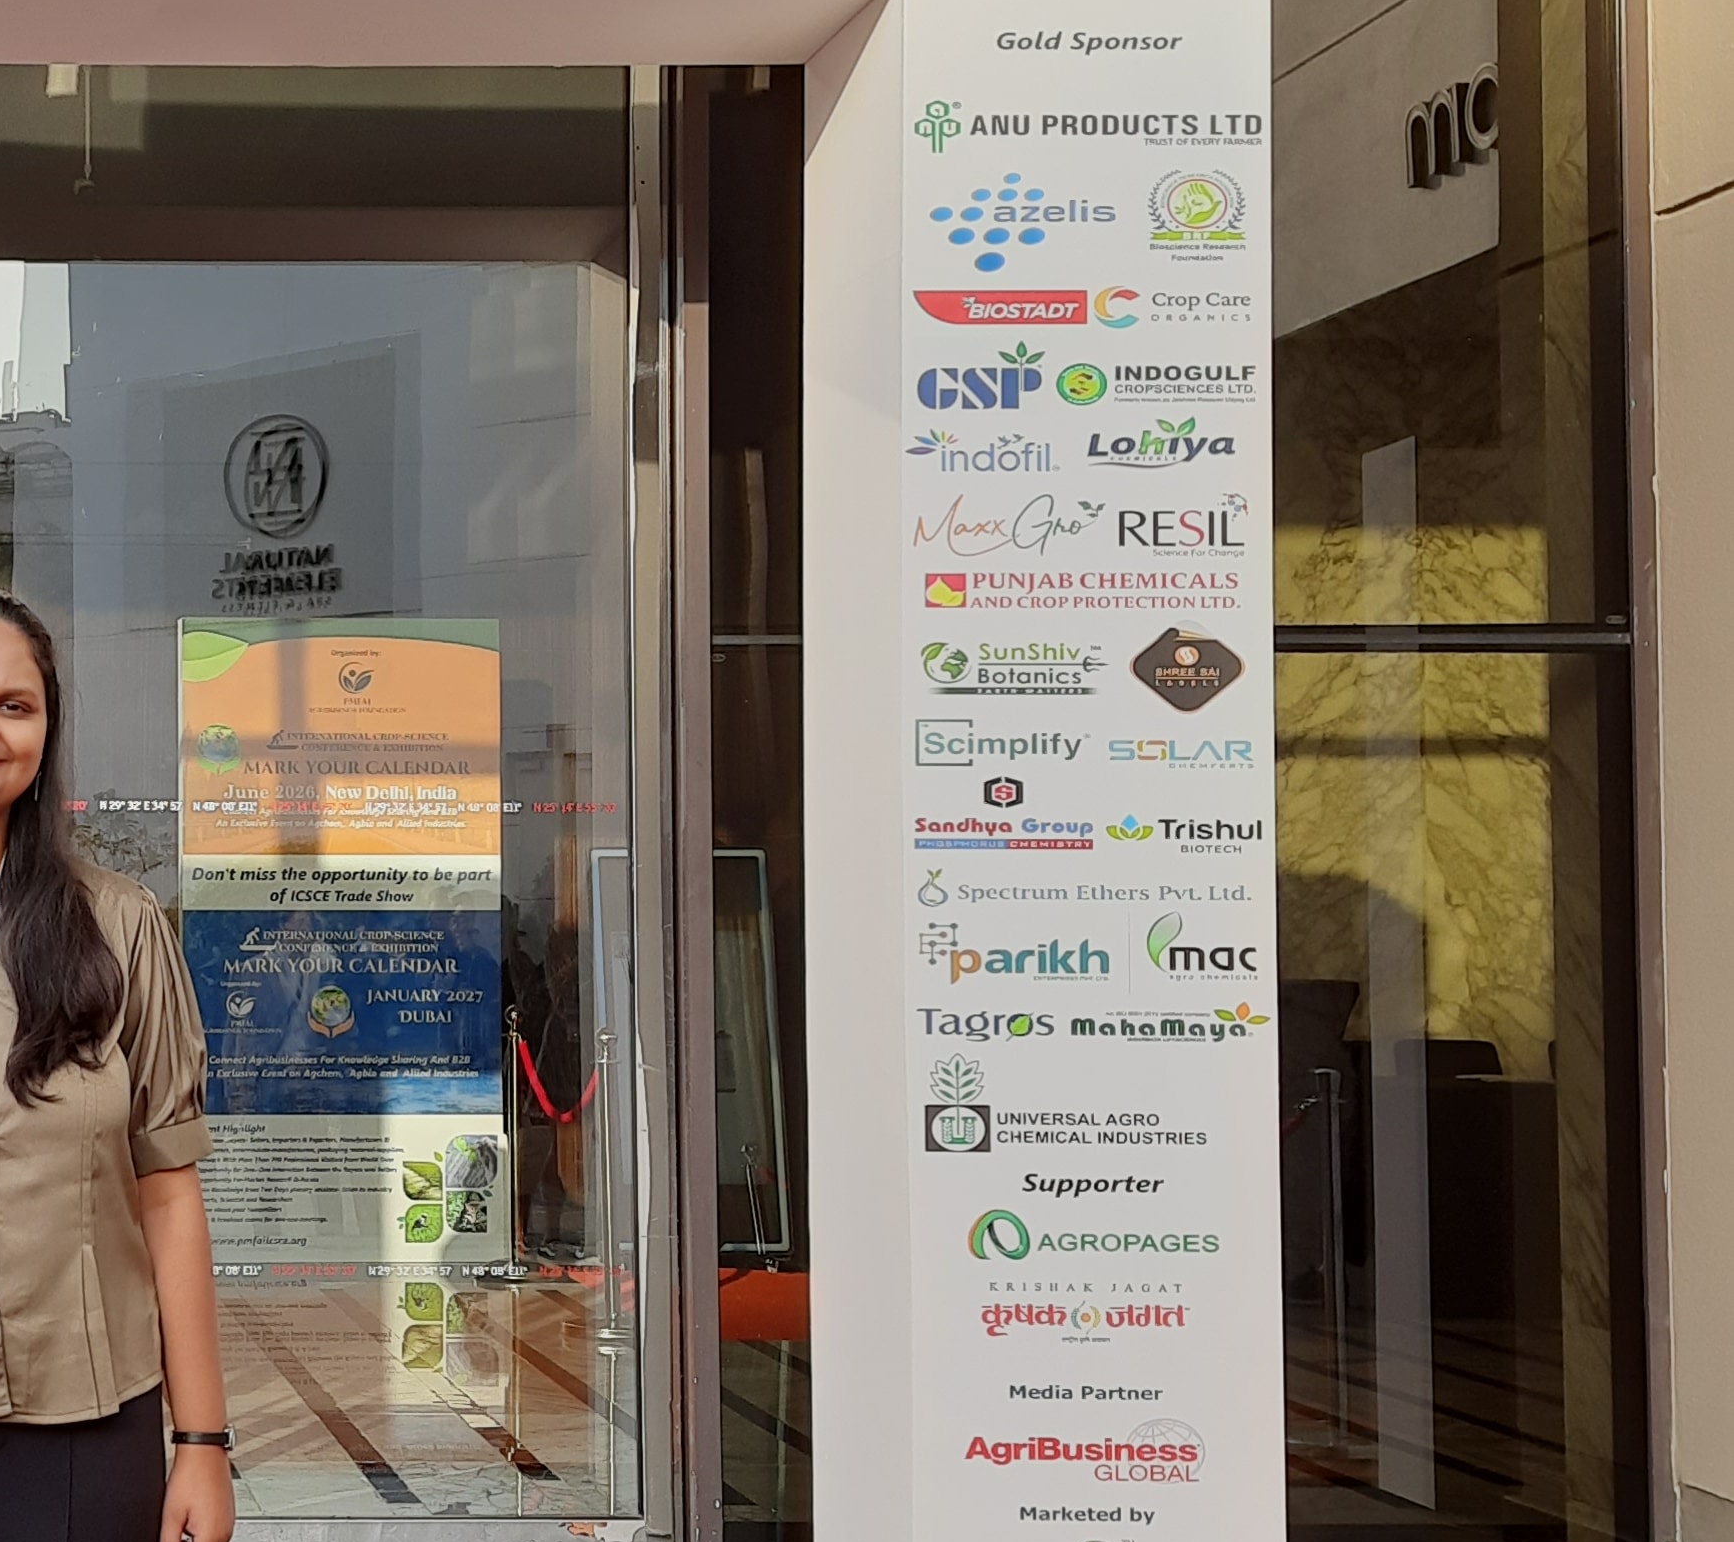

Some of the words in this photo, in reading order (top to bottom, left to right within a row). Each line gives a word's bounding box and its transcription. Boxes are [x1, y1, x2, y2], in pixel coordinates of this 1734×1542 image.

[997, 31, 1062, 50] Gold
[1070, 32, 1182, 55] Sponsor
[970, 115, 1029, 135] ANU
[1042, 115, 1198, 135] PRODUCTS
[1210, 115, 1261, 135] LTD
[968, 300, 1079, 319] BIOSTADT
[1115, 366, 1255, 381] INDOGULF
[973, 573, 1073, 594] PUNJAB
[1080, 573, 1238, 589] CHEMICALS
[970, 596, 1012, 608] AND
[1017, 596, 1068, 608] CROP
[1074, 596, 1195, 608] PROTECTION
[1201, 597, 1240, 608] LTD.
[979, 643, 1080, 660] SunShiv
[978, 668, 1081, 684] Botanics
[924, 732, 1082, 760] Scimplify
[244, 761, 300, 775] MARK
[305, 761, 359, 775] YOUR
[366, 761, 470, 775] CALENDAR
[223, 785, 269, 800] June
[275, 785, 319, 801] 2026,
[325, 785, 362, 800] New
[366, 785, 413, 801] Delhi,
[417, 785, 456, 800] India
[915, 818, 1012, 836] Sandhya
[1021, 818, 1093, 837] Group
[1158, 819, 1262, 840] Trishul
[1181, 845, 1241, 854] BIOTECH
[192, 867, 236, 882] Don't
[240, 868, 277, 882] miss
[281, 867, 307, 881] the
[312, 868, 406, 885] opportunity
[413, 869, 427, 881] to
[433, 868, 452, 881] be
[457, 869, 492, 885] part
[270, 889, 286, 904] of
[290, 891, 330, 902] ICSCE
[334, 890, 372, 902] Trade
[376, 890, 414, 902] Show
[958, 885, 1068, 903] Spectrum
[1077, 885, 1149, 900] Ethers
[1159, 886, 1202, 900] Pvt.
[1210, 885, 1251, 900] Ltd.
[223, 958, 281, 973] MARK
[287, 958, 344, 973] YOUR
[349, 958, 459, 974] CALENDAR
[366, 990, 441, 1004] JANUARY
[446, 990, 484, 1003] 2027
[398, 1010, 452, 1023] DUBAI
[997, 1113, 1100, 1126] UNIVERSAL
[1106, 1114, 1159, 1126] AGRO
[997, 1131, 1092, 1144] CHEMICAL
[1098, 1132, 1206, 1145] INDUSTRIES
[1022, 1174, 1164, 1198] Supporter
[1038, 1233, 1219, 1252] AGROPAGES
[966, 1437, 1198, 1465] AgriBusiness
[1094, 1465, 1199, 1482] GLOBAL
[1020, 1507, 1121, 1521] Marketed
[1130, 1508, 1155, 1525] by
